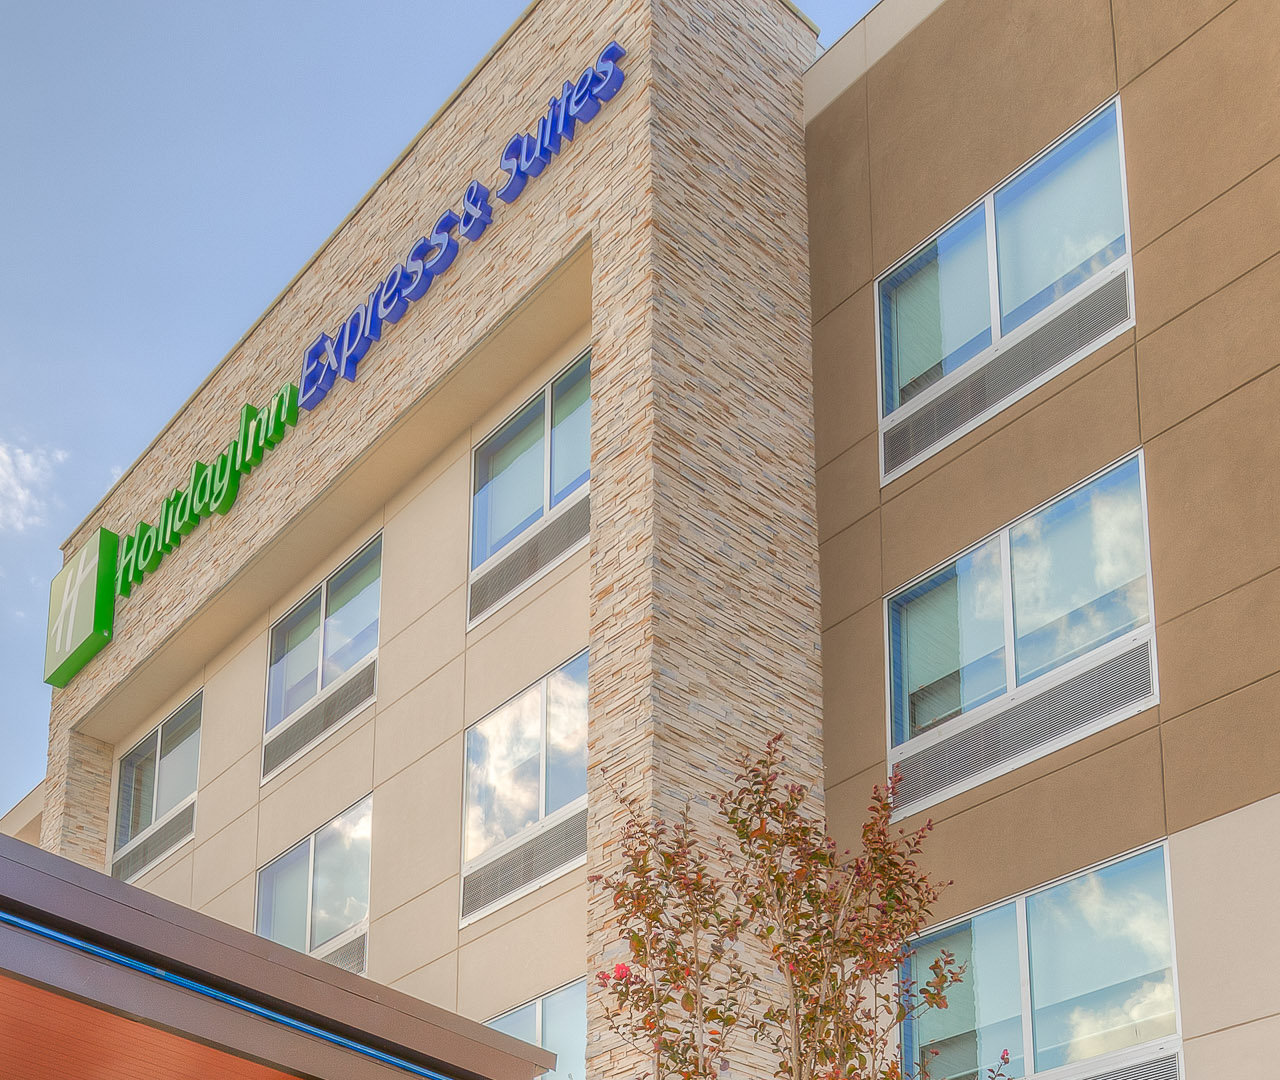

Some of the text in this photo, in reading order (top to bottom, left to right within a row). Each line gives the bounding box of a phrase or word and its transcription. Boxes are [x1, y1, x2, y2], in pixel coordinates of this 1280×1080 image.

[116, 41, 626, 598] Holiday Inn Express & Suites
